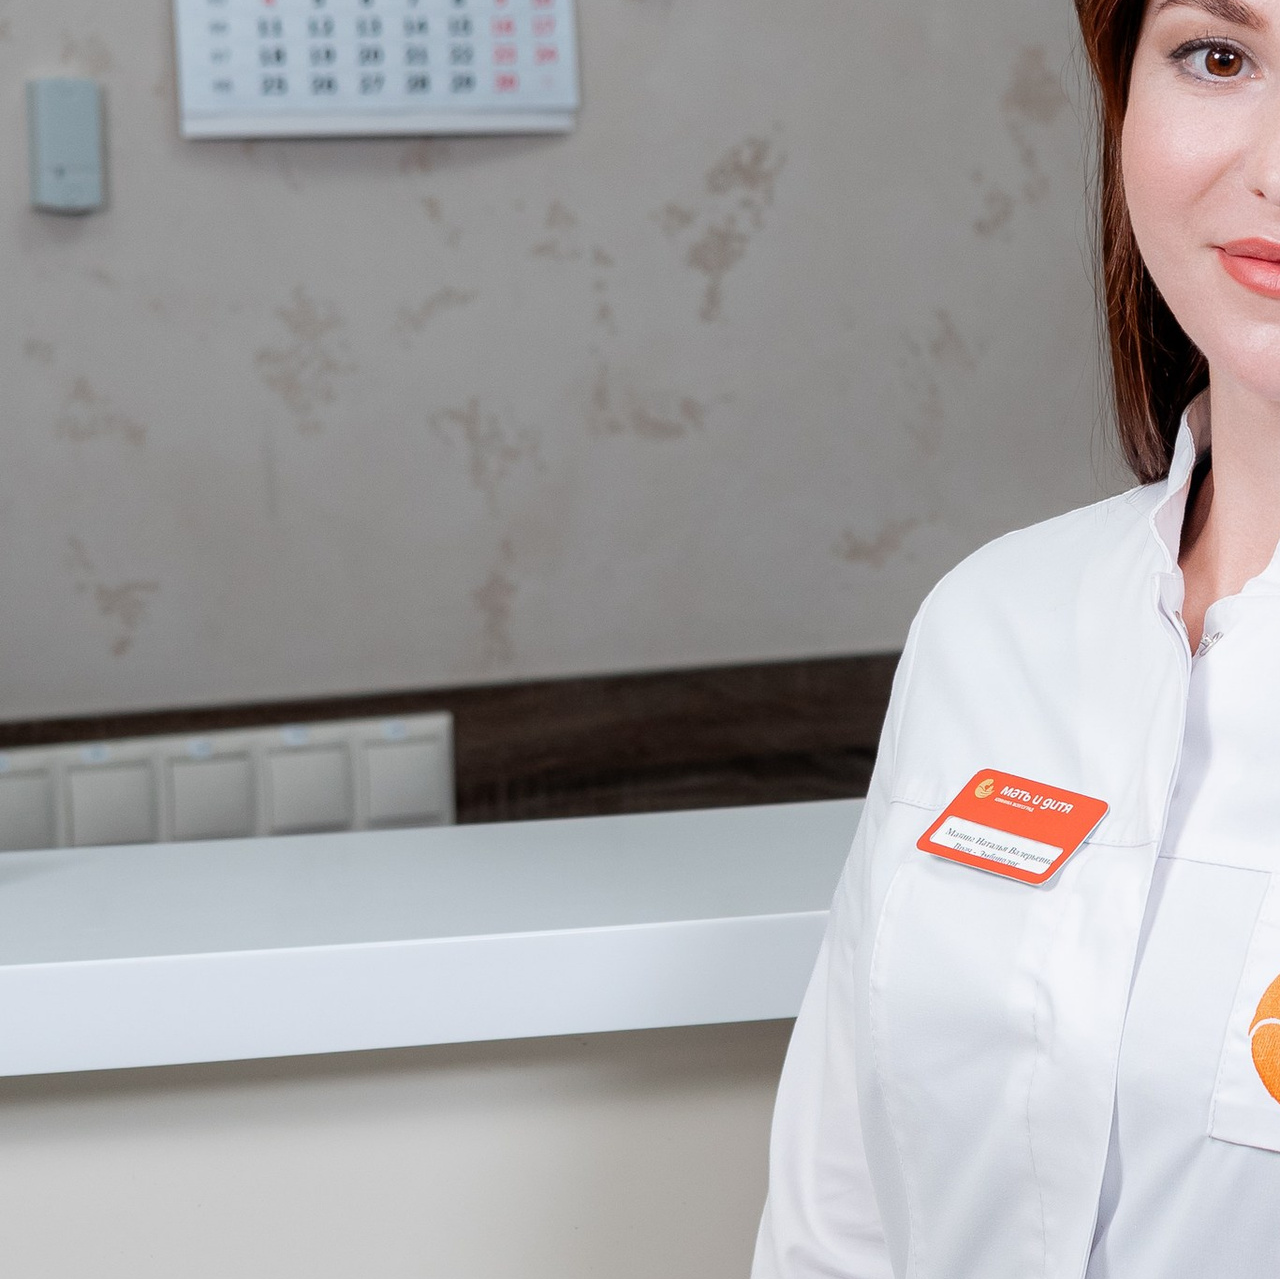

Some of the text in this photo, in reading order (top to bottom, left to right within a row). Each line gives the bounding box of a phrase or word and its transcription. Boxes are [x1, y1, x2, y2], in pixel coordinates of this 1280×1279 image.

[1032, 794, 1043, 805] и
[976, 837, 1008, 853] Наталья
[1008, 847, 1053, 865] Валерьевна
